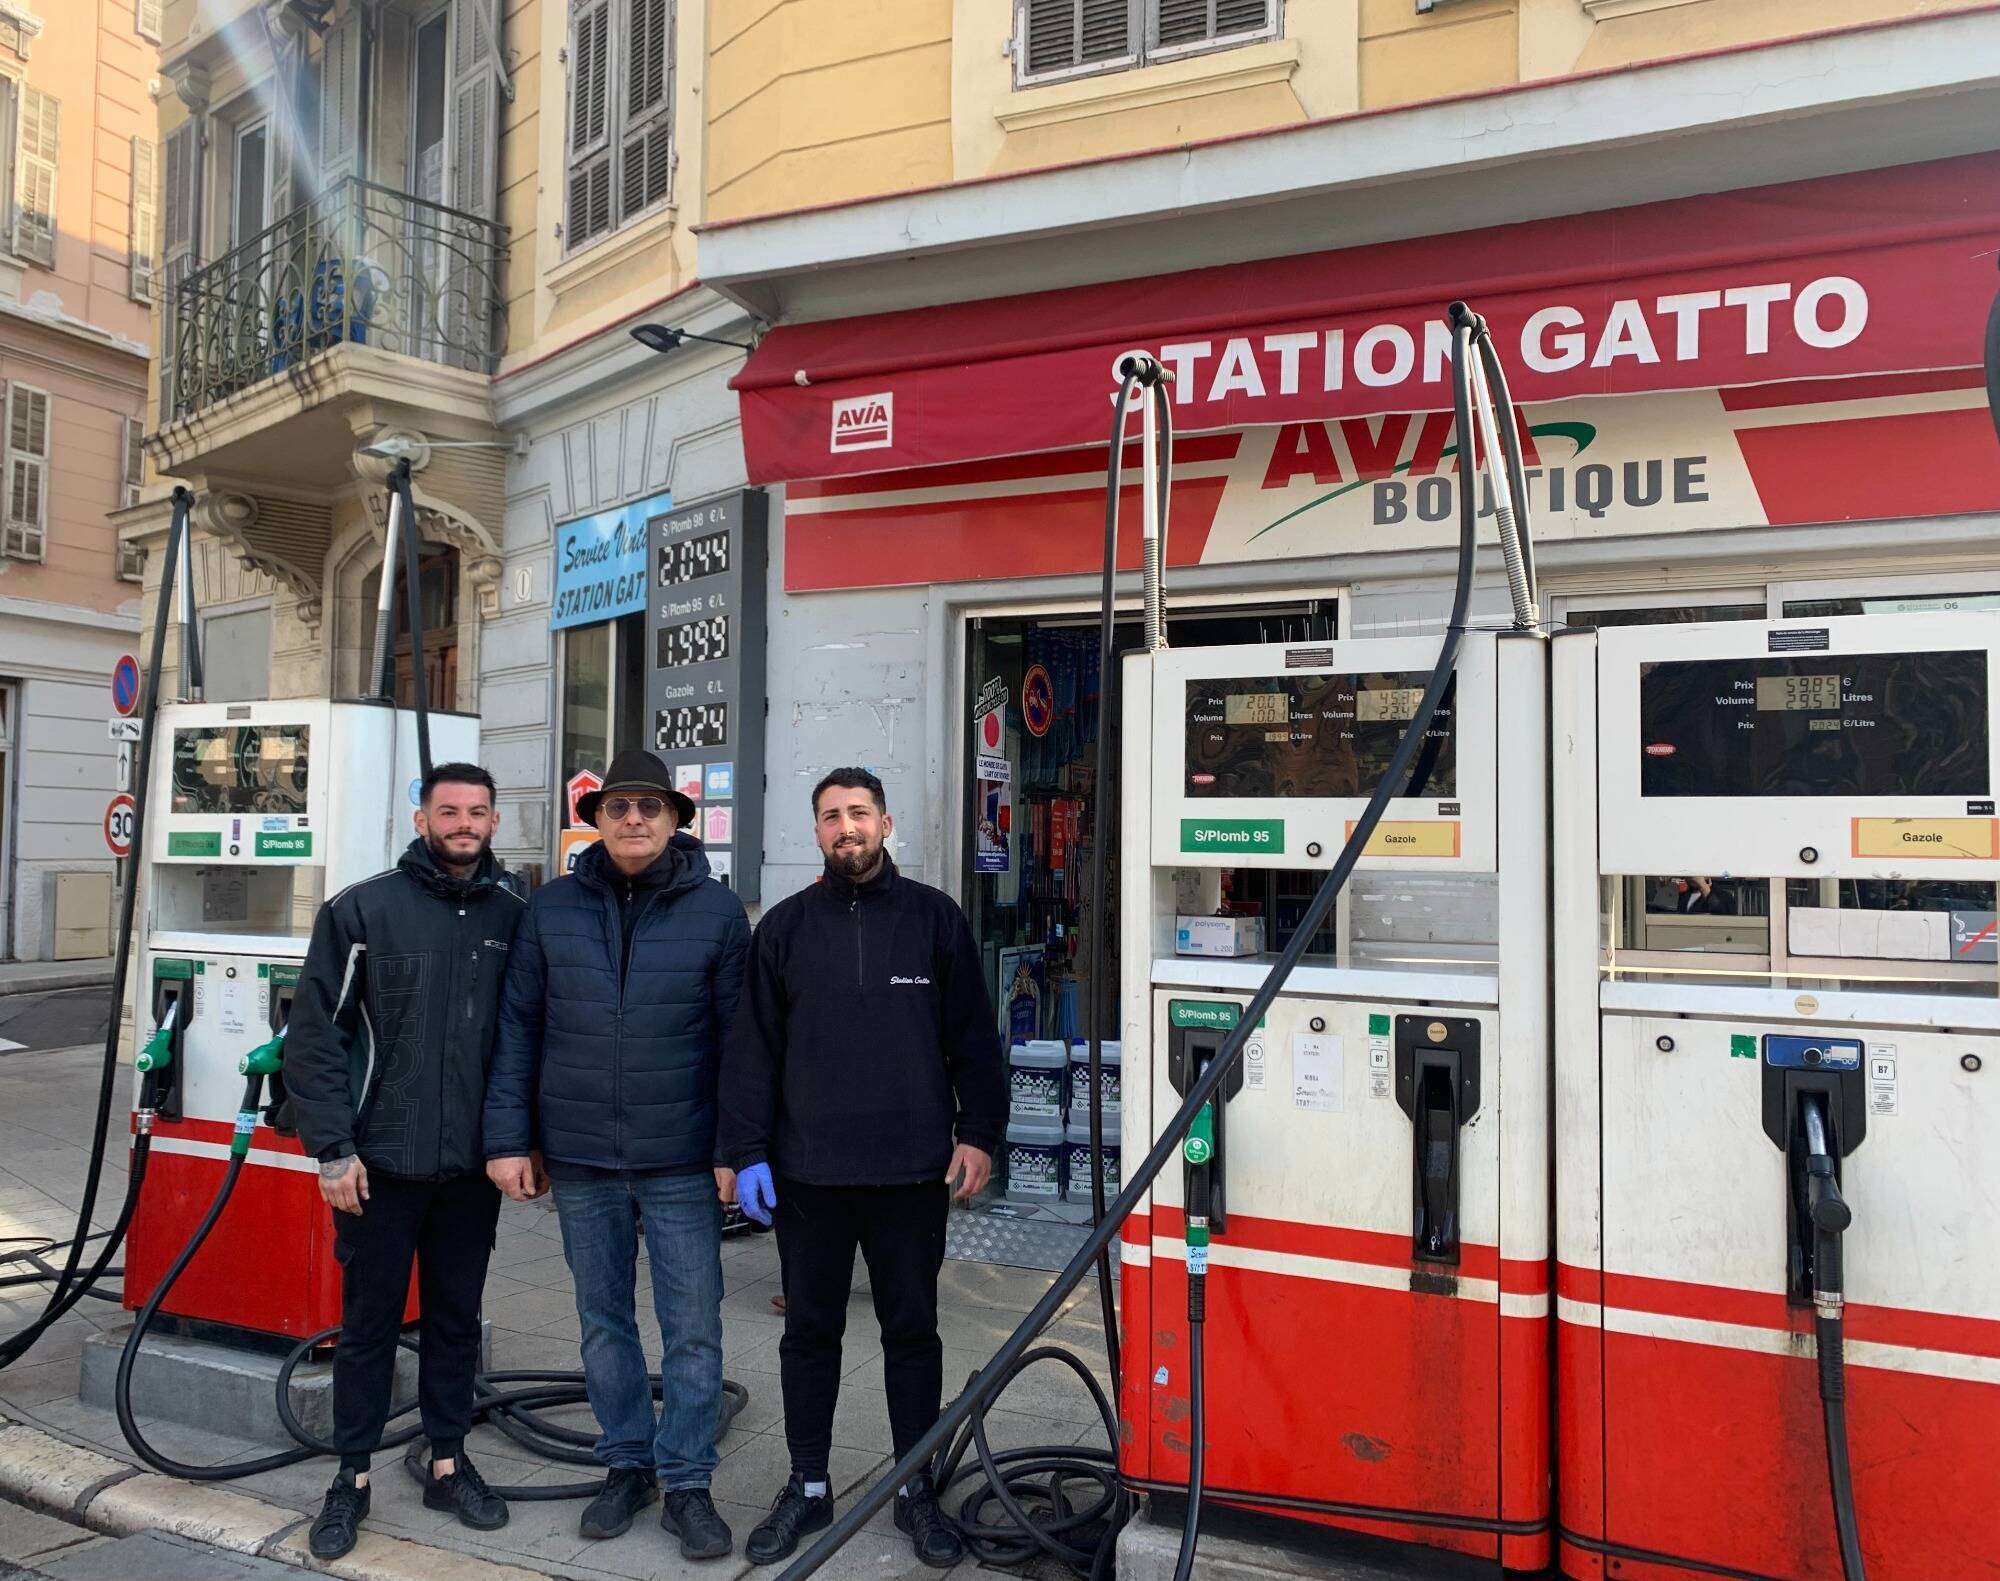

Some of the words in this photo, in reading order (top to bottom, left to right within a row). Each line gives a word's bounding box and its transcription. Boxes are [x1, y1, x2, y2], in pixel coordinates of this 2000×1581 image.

[1109, 319, 1454, 412] STATION
[1520, 276, 1869, 373] GATTO
[662, 516, 692, 537] S/Plomb
[692, 512, 704, 529] 98
[709, 507, 726, 523] €/L
[563, 535, 611, 573] Service
[660, 535, 728, 587] 2.044
[556, 578, 615, 620] STATION
[616, 571, 646, 605] GAT
[661, 600, 691, 619] S/Plomb
[692, 598, 703, 613] 95
[708, 593, 725, 609] €/L
[1944, 602, 1958, 610] 06
[668, 616, 726, 667] 1.999
[665, 683, 694, 699] Gazole
[707, 680, 724, 695] €/L
[1734, 680, 1754, 690] Prix
[1208, 698, 1223, 706] Prix
[1290, 695, 1296, 703] €
[1337, 693, 1354, 702] Prix
[1715, 697, 1755, 705] Volume
[1842, 692, 1873, 702] Litres
[1194, 714, 1223, 723] Volume
[1290, 712, 1313, 720] Litres
[1322, 711, 1354, 719] Volume
[656, 705, 725, 750] 2.024
[1738, 721, 1754, 729] Prix
[1843, 719, 1876, 728] €/Litre
[1426, 729, 1450, 737] €/Litre
[111, 811, 133, 839] 30
[1194, 829, 1250, 843] S/Plomb
[1253, 830, 1269, 842] 95
[1384, 833, 1417, 844] Gazole
[1902, 832, 1943, 844] Gazole
[262, 840, 294, 850] S/Plomb
[295, 839, 305, 849] 95
[1178, 1008, 1217, 1020] S/Plomb
[1219, 1011, 1231, 1021] 95
[1375, 1054, 1383, 1063] B7
[1878, 1065, 1888, 1074] B7
